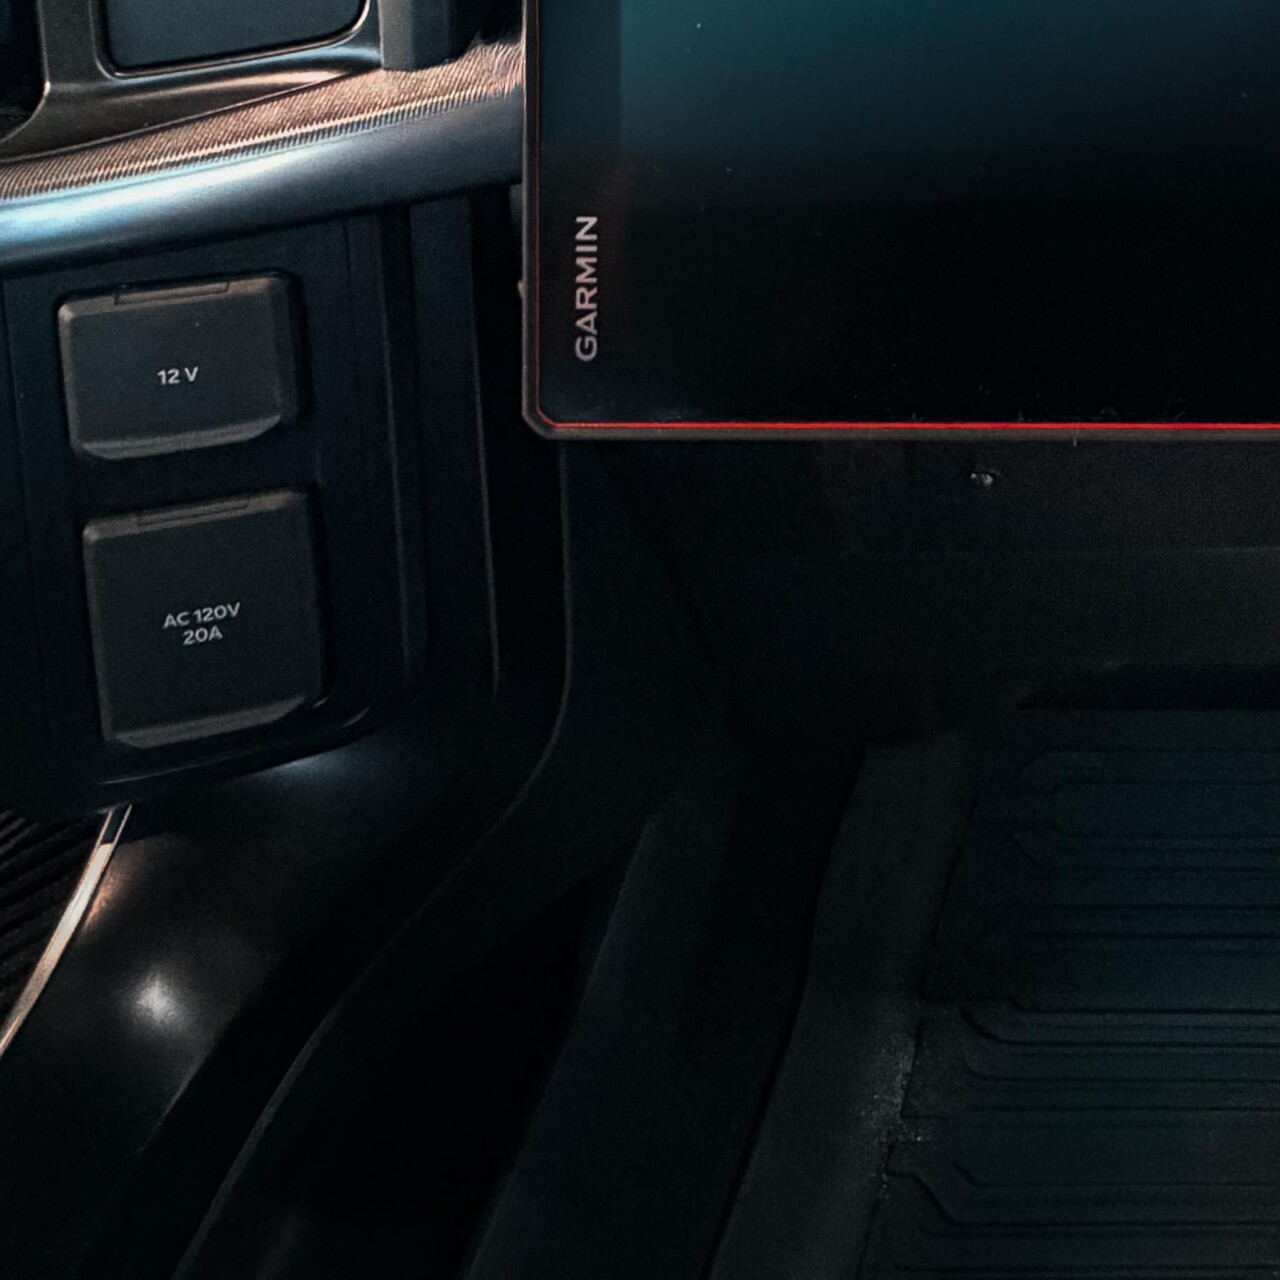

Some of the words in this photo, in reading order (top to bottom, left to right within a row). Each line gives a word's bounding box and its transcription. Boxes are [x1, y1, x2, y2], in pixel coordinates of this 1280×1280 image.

[575, 216, 598, 361] GARMIN
[157, 368, 181, 386] 12
[184, 366, 199, 382] V
[162, 612, 190, 629] AC
[193, 601, 241, 623] 120V
[182, 625, 223, 645] 20A
